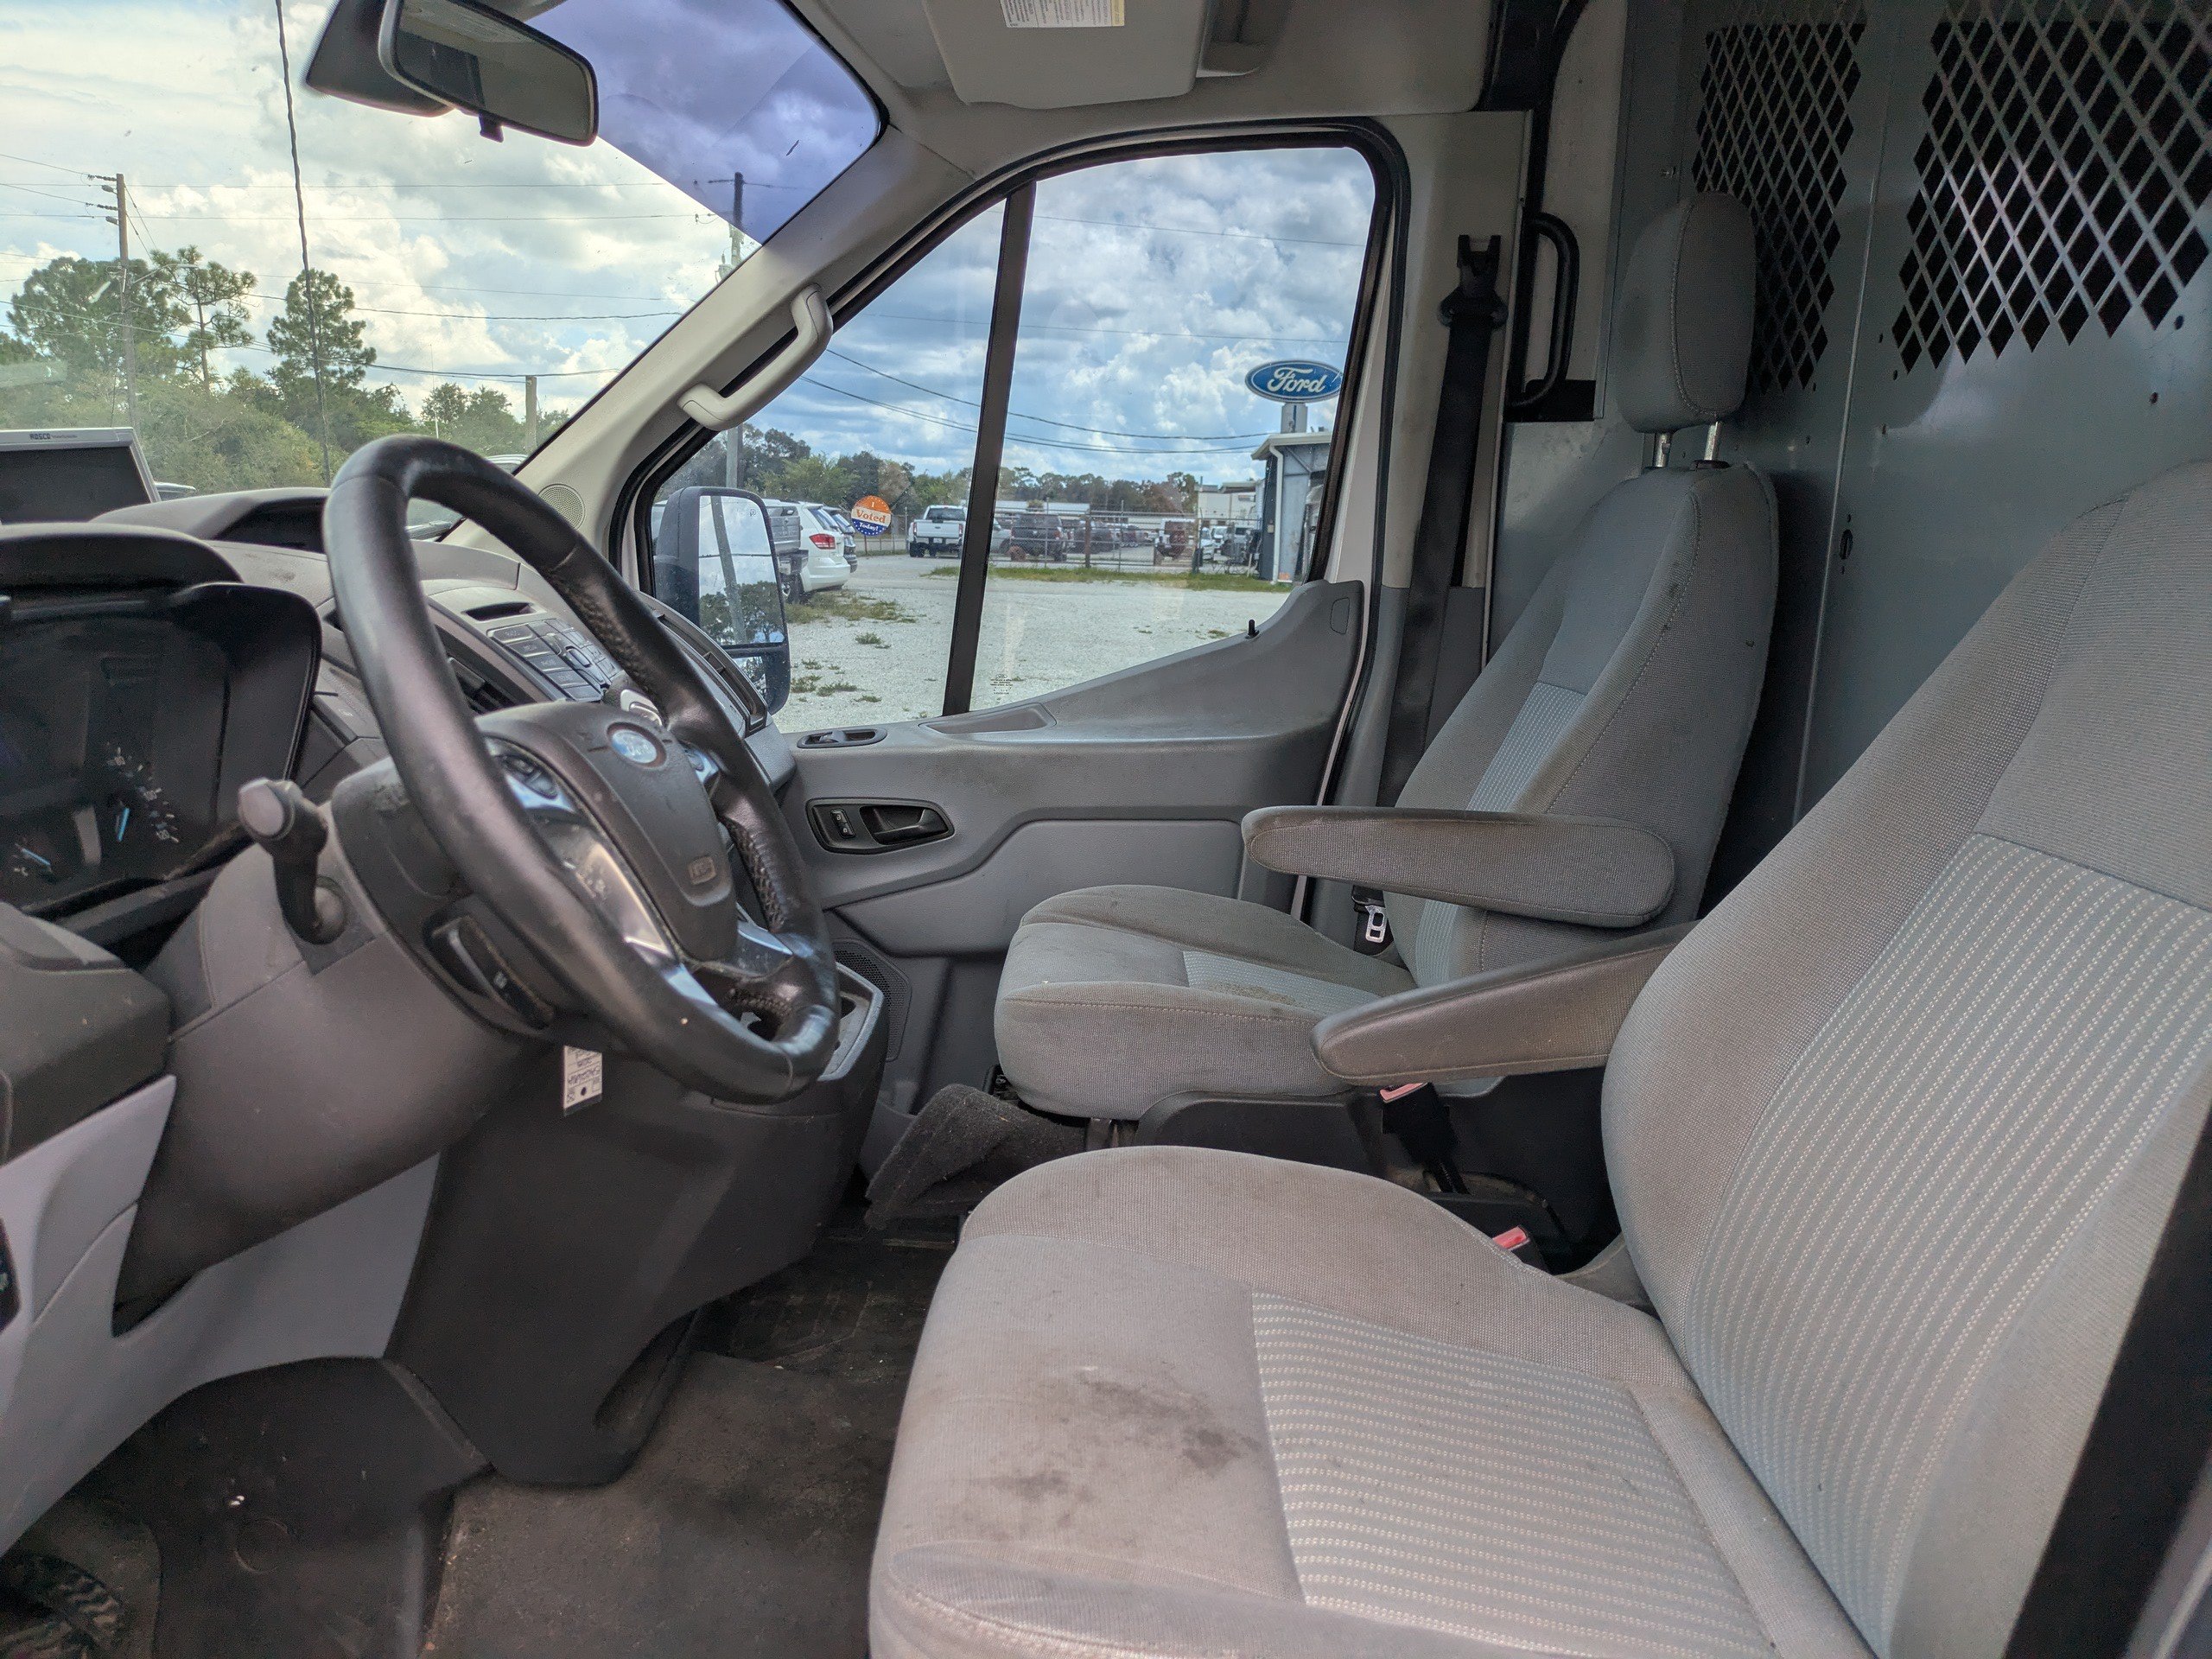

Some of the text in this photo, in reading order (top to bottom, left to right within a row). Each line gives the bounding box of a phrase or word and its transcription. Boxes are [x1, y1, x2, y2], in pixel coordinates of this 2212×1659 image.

[1267, 366, 1326, 393] Ford
[856, 509, 886, 524] Voted
[859, 522, 879, 531] Today!
